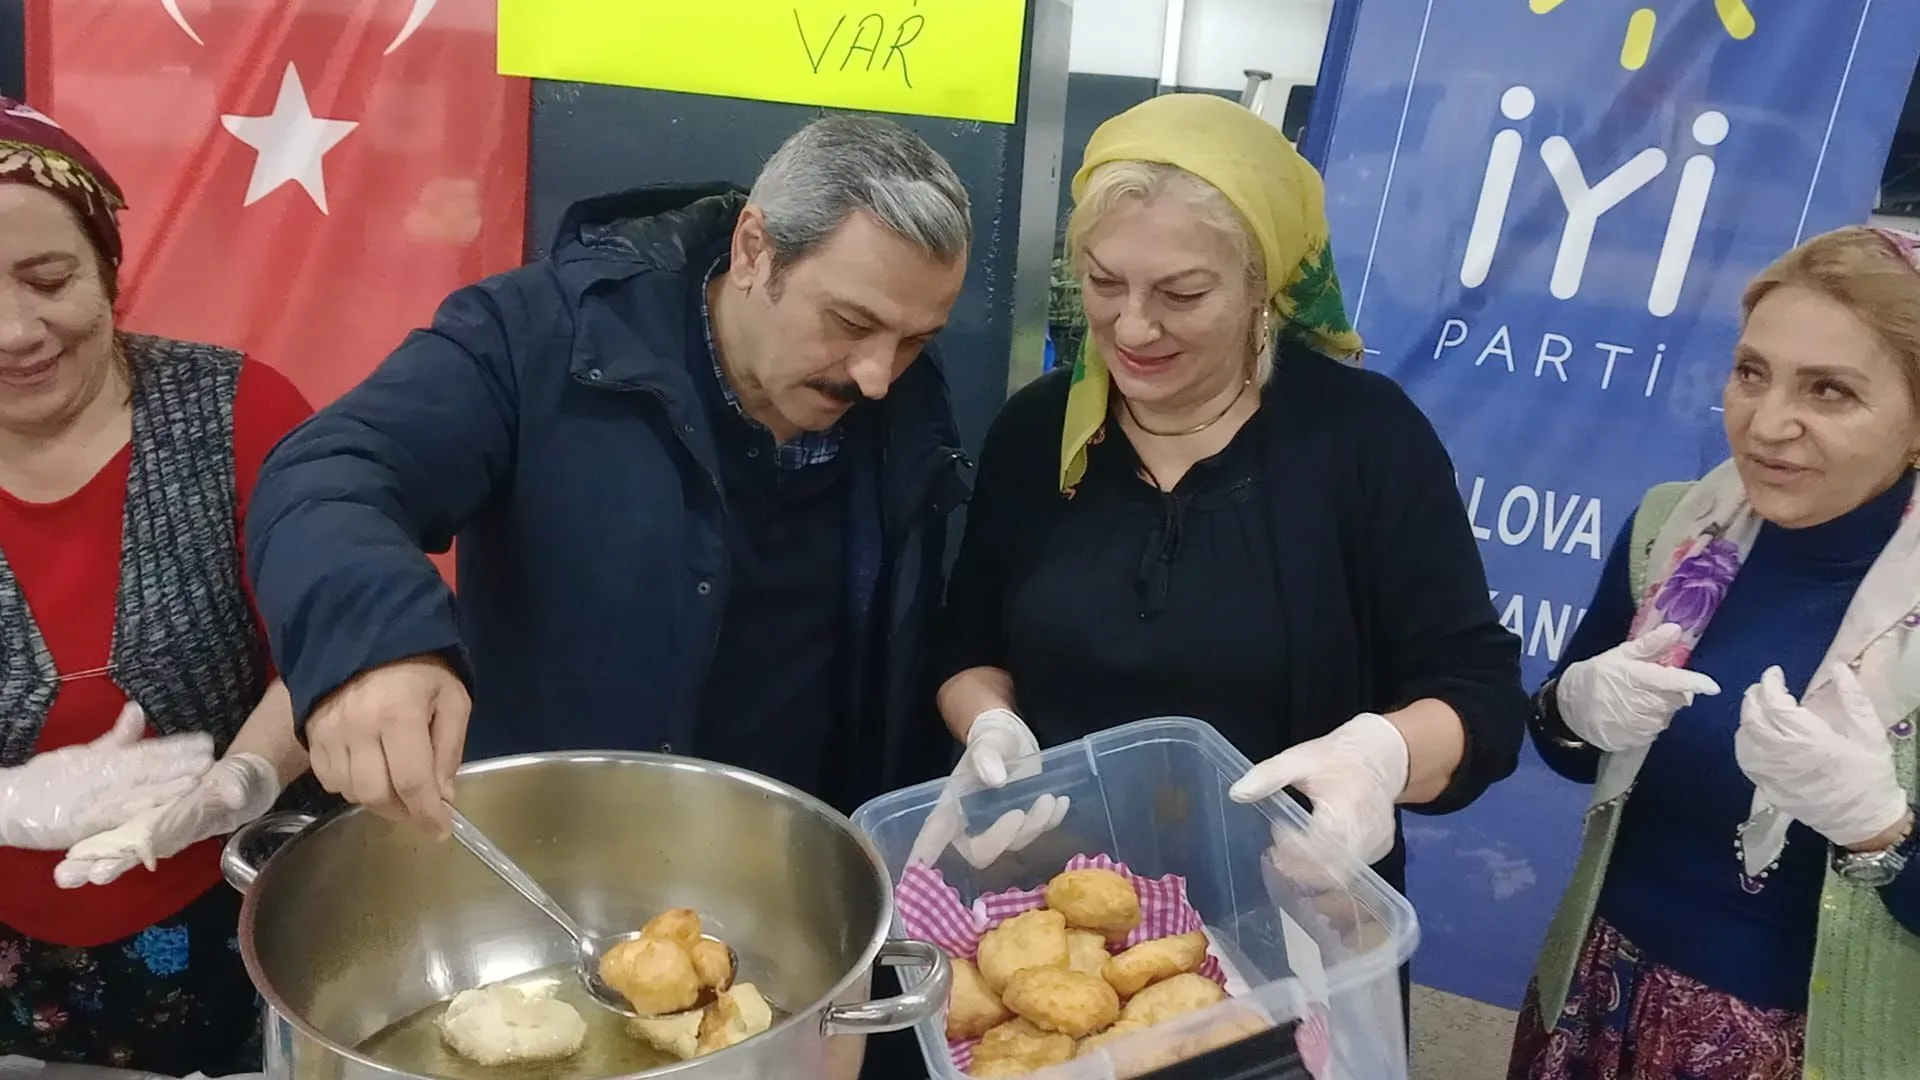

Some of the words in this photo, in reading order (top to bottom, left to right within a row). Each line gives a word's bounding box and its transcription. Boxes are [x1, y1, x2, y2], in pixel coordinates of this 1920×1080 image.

[793, 8, 925, 89] VAR
[1433, 318, 1667, 397] PARTİ
[1454, 471, 1601, 560] LOVA
